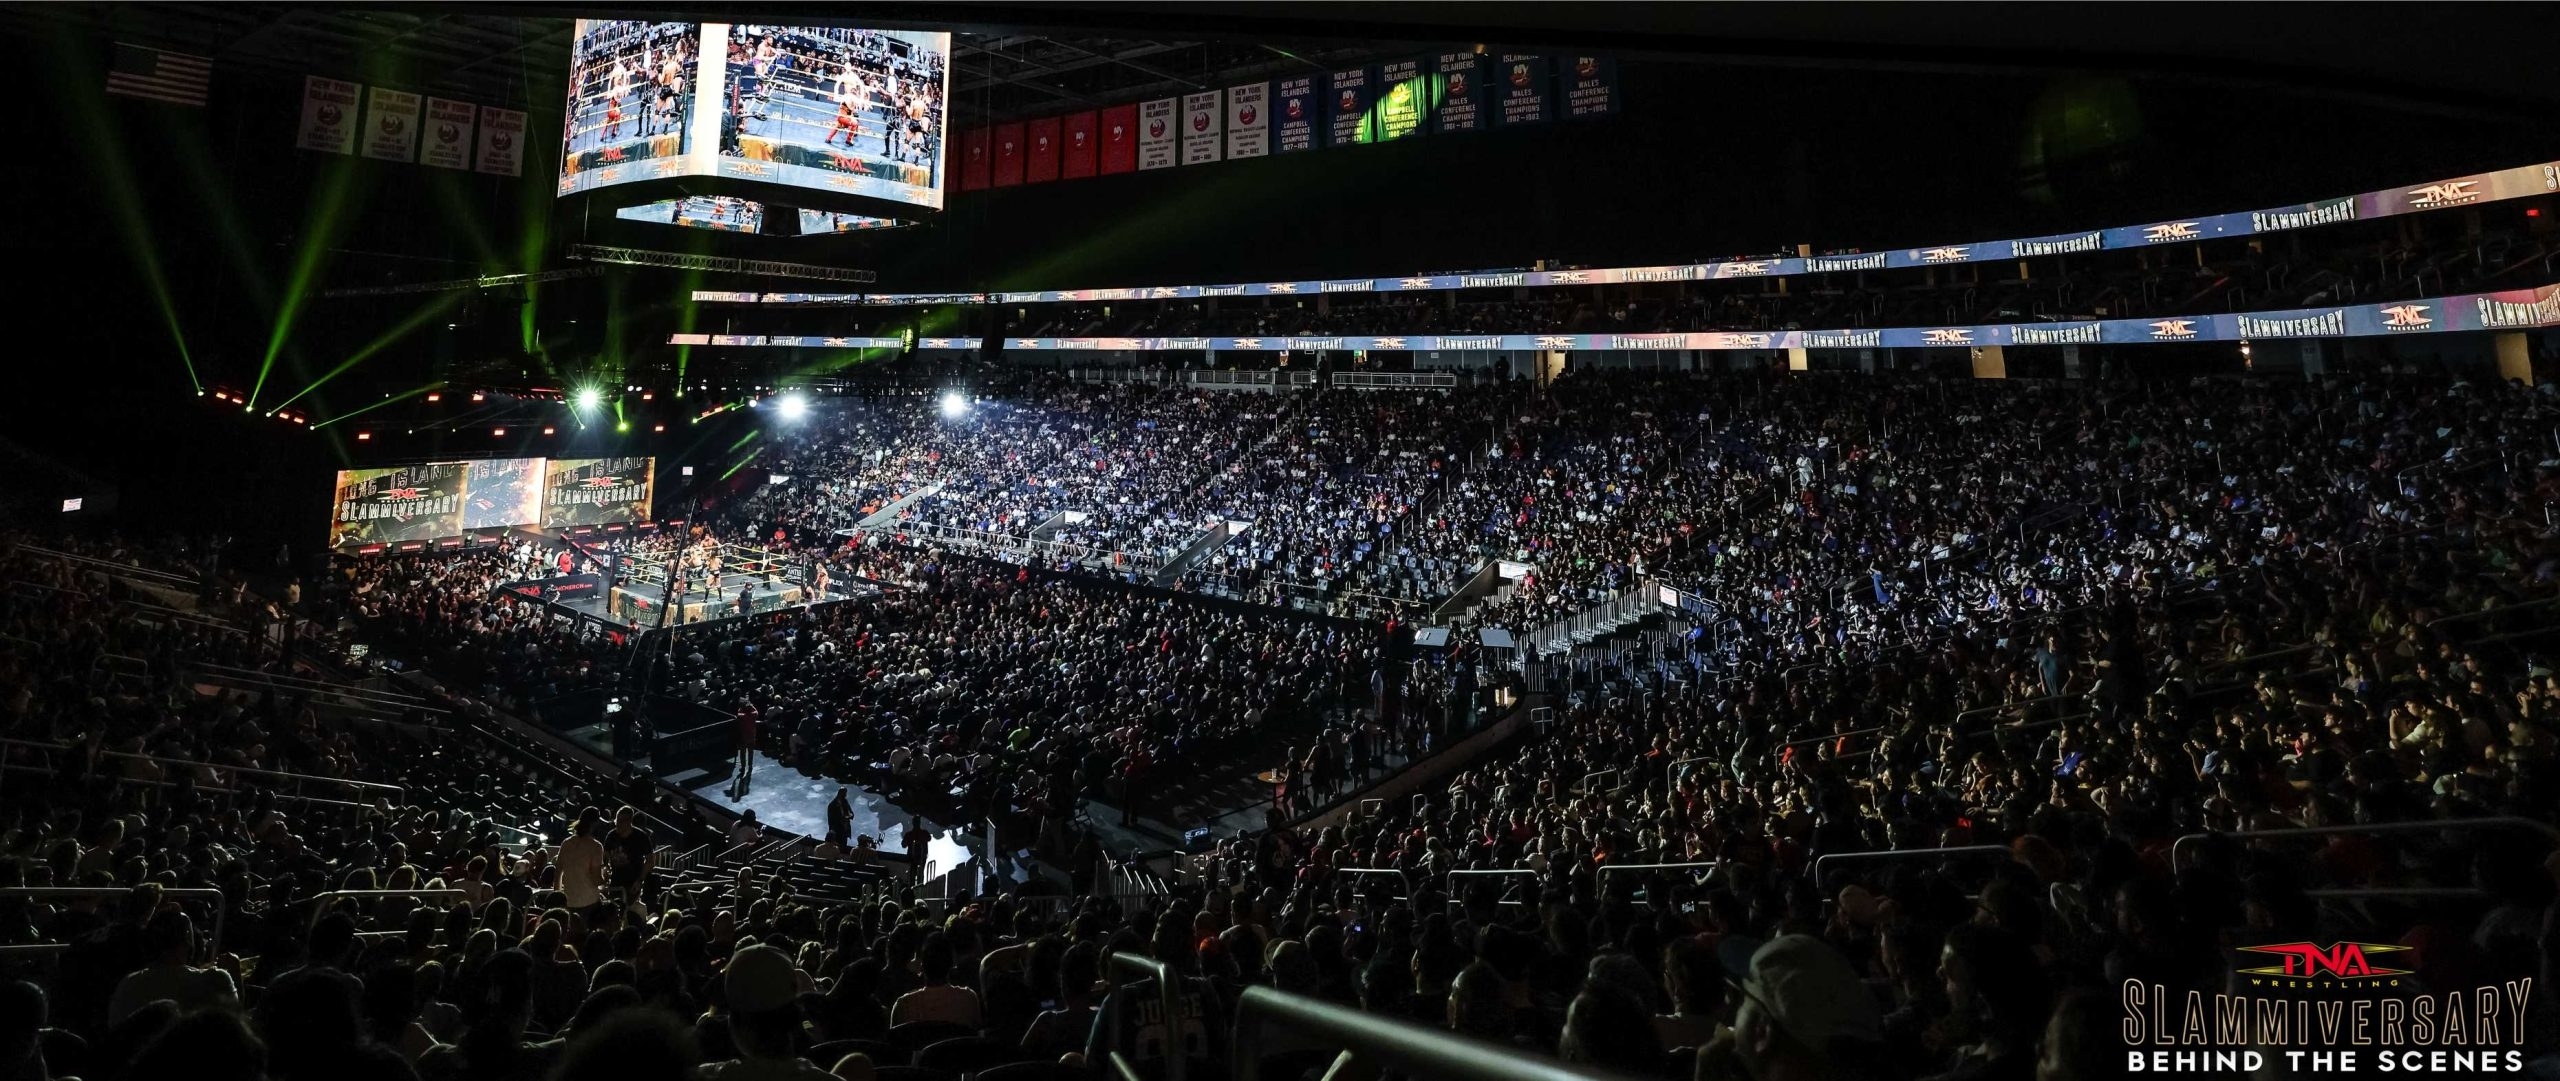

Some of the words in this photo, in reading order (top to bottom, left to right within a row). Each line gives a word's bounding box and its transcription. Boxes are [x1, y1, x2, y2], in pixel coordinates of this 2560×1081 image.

[1441, 54, 1454, 64] NEW
[1384, 64, 1397, 73] NEW
[1399, 61, 1416, 70] YORK
[1440, 60, 1475, 73] ISLANDERS
[1334, 72, 1346, 81] NEW
[1349, 69, 1364, 78] YORK
[1384, 70, 1417, 82] ISLANDERS
[1282, 81, 1294, 89] NEW
[1296, 78, 1310, 87] YORK
[1334, 77, 1364, 89] ISLANDERS
[1578, 79, 1600, 89] WALES
[1281, 86, 1310, 98] ISLANDERS
[1512, 88, 1532, 97] WALES
[1569, 86, 1610, 99] CONFERENCE
[1449, 97, 1468, 106] WALES
[1503, 96, 1541, 107] CONFERENCE
[1571, 95, 1608, 107] CHAMPIONS
[1440, 103, 1476, 115] CONFERENCE
[1505, 104, 1540, 115] CHAMPIONS
[1336, 112, 1361, 122] CAMPBELL
[1384, 113, 1419, 123] CONFERENCE
[1442, 112, 1475, 123] CHAMPIONS
[1283, 120, 1308, 129] CAMPBELL
[1333, 119, 1364, 130] CONFERENCE
[1386, 121, 1417, 131] CHAMPIONS
[1281, 127, 1310, 137] CONFERENCE
[1334, 127, 1364, 137] CHAMPIONS
[1282, 134, 1310, 144] CHAMPIONS
[2253, 197, 2355, 233] SLAMMIVERSARY
[2011, 231, 2102, 257] SLAMMIVERSARY
[1806, 252, 1886, 273] SLAMMIVERSARY
[1621, 266, 1694, 282] SLAMMIVERSARY
[1320, 280, 1374, 292] SLAMMIVERSARY
[1461, 273, 1523, 288] SLAMMIVERSARY
[1199, 285, 1246, 297] SLAMMIVERSARY
[2237, 309, 2344, 338] SLAMMIVERSARY
[1802, 330, 1881, 348] SLAMMIVERSARY
[2011, 323, 2101, 344] SLAMMIVERSARY
[1163, 338, 1210, 349] SLAMMIVERSARY
[1287, 337, 1342, 350] SLAMMIVERSARY
[1436, 336, 1502, 350] SLAMMIVERSARY
[1611, 334, 1686, 349] SLAMMIVERSARY
[549, 482, 647, 506] SLAMMIVERSARY
[340, 493, 460, 522] SLAMMIVERSARY
